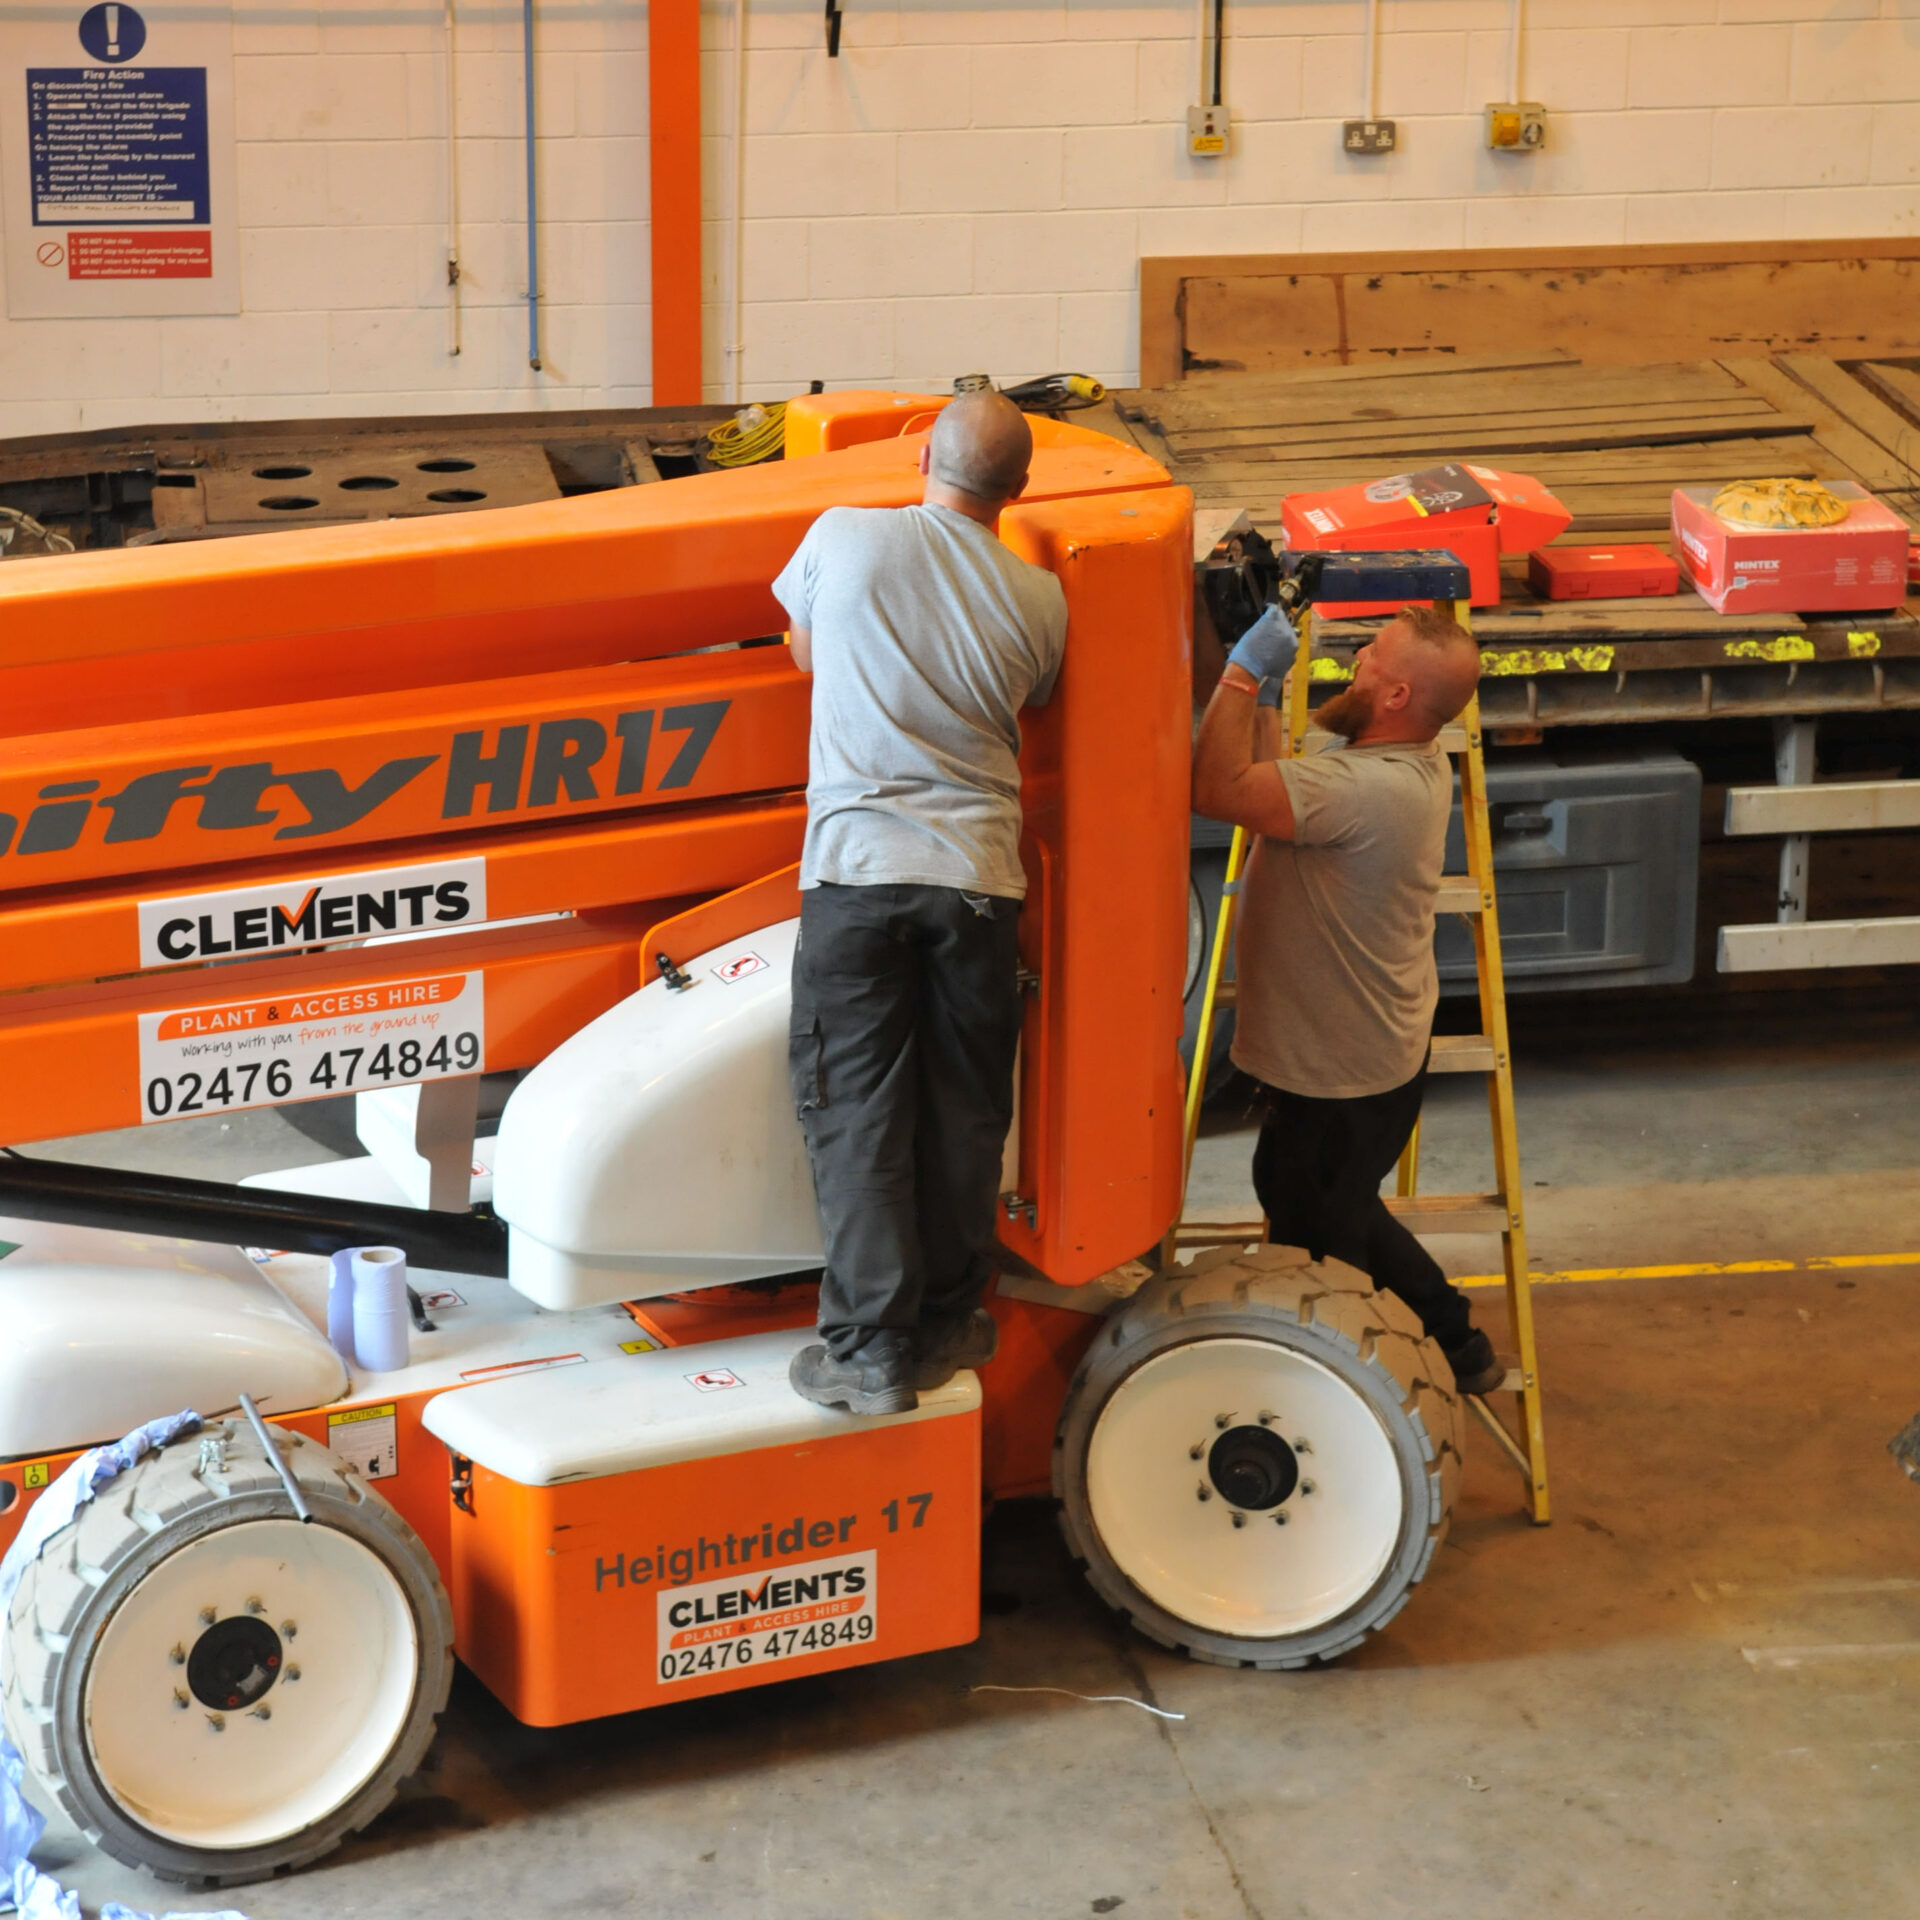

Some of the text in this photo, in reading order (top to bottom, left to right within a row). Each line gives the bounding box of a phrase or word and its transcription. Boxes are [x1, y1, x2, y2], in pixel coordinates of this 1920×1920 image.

[83, 70, 145, 79] Fire Action
[32, 82, 45, 90] On
[47, 82, 98, 91] discovering
[108, 82, 124, 90] fire
[46, 92, 82, 101] Operate
[90, 102, 102, 110] To
[103, 102, 120, 110] call
[157, 102, 190, 110] brigade
[47, 112, 77, 120] Attack
[79, 112, 93, 120] the
[96, 112, 111, 120] fire
[122, 112, 159, 121] possible
[64, 123, 112, 132] appliances
[115, 122, 153, 131] provided
[115, 132, 157, 141] assembly
[159, 132, 182, 141] point
[49, 143, 83, 152] hearing
[85, 143, 100, 151] the
[48, 153, 75, 161] Leave
[77, 153, 92, 161] the
[94, 153, 129, 162] building
[131, 153, 142, 162] by
[117, 173, 147, 181] behind
[149, 174, 166, 182] you
[50, 184, 80, 192] Report
[82, 184, 92, 192] to
[111, 183, 153, 192] assembly
[155, 183, 177, 191] point
[37, 194, 63, 202] YOUR
[1734, 560, 1780, 569] MINTEX
[0, 700, 733, 859] ifty HR17
[157, 880, 471, 960] CLEMENTS
[180, 984, 441, 1033] PLANT & ACCESS HIRE
[238, 1035, 266, 1050] with
[271, 1032, 292, 1047] you
[298, 1027, 337, 1044] from
[343, 1022, 364, 1035] the
[369, 1016, 417, 1037] ground
[422, 1013, 441, 1028] up
[147, 1032, 479, 1116] 02476 474849
[341, 1408, 382, 1421] CAUTION
[595, 1493, 934, 1592] Heightrider 17
[669, 1567, 866, 1628] CLEMENTS
[683, 1602, 849, 1644] PLANT & ACCESS HIRE
[660, 1615, 873, 1679] 02476 474849
